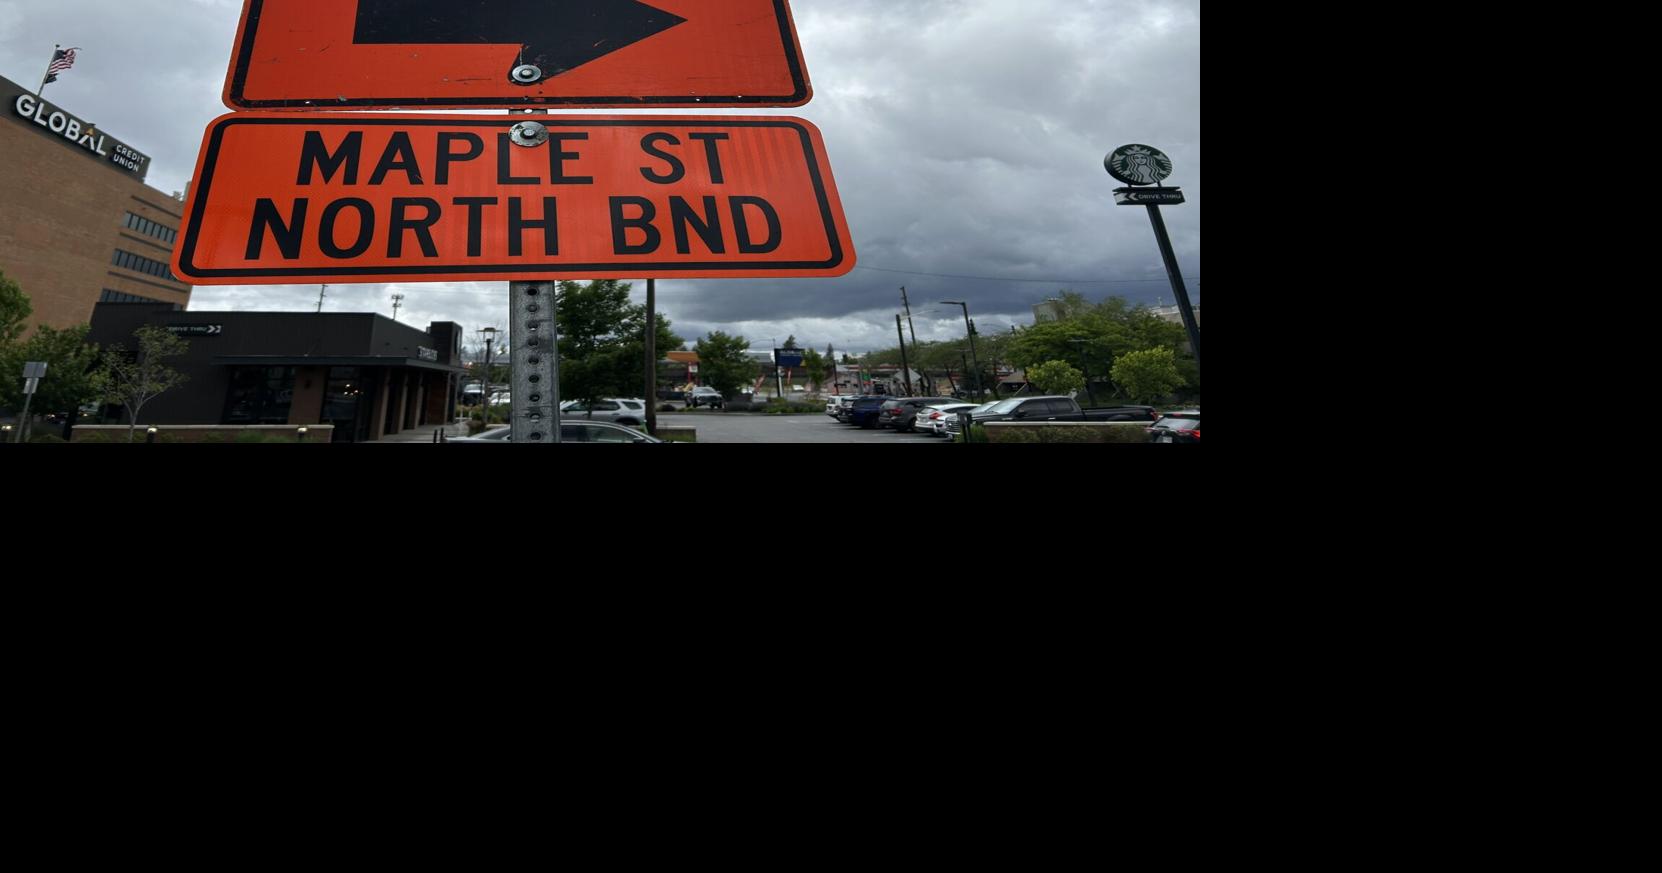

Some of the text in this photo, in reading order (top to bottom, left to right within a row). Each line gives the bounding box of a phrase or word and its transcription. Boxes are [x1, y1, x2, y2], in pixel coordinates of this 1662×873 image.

[16, 94, 107, 156] GLOBAL
[113, 154, 139, 172] UNION
[116, 145, 145, 164] CREDIT
[296, 131, 730, 185] MAPLE ST
[245, 196, 783, 260] NORTH BND
